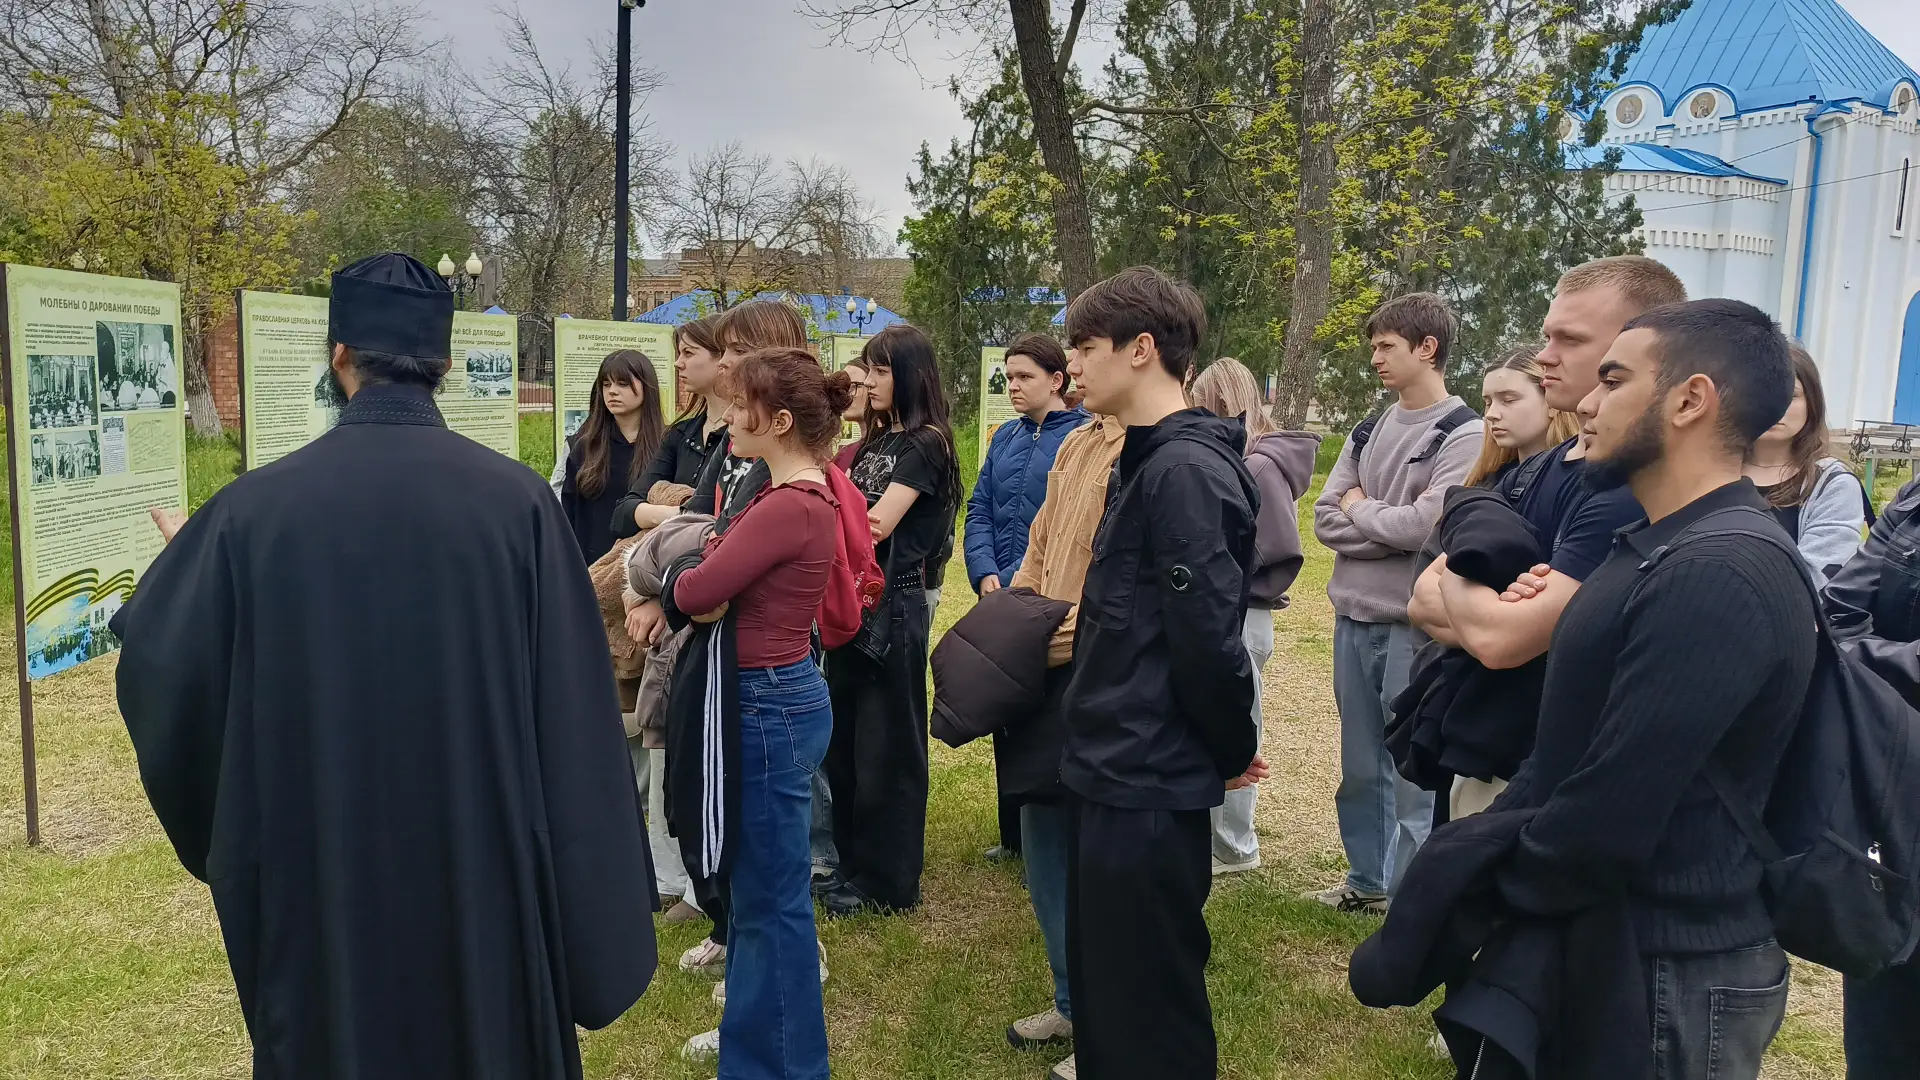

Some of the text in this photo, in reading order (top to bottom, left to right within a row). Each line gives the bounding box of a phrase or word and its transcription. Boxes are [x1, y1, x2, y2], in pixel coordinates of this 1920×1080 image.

[40, 297, 161, 316] МОЛЕБНЫ О ДАРОВАНИИ ПОБЕДЫ
[252, 314, 290, 323] ПРАВОСЛАВНАЯ
[290, 316, 310, 324] ЦЕРКОВЬ
